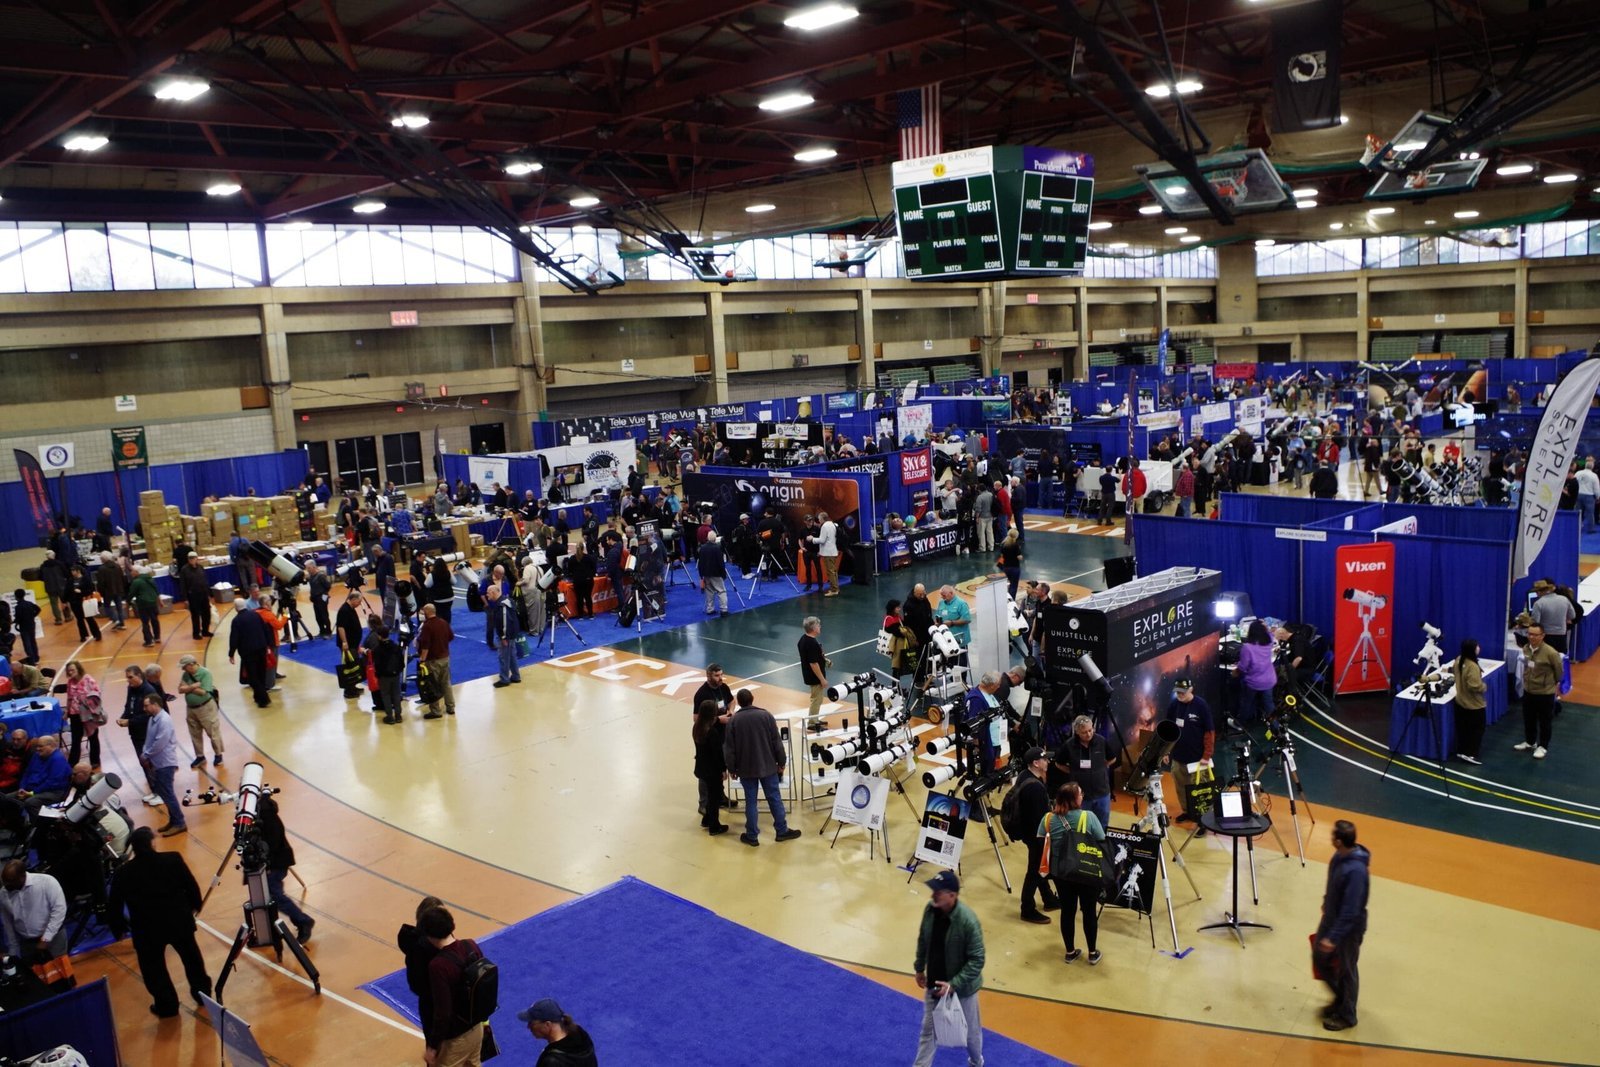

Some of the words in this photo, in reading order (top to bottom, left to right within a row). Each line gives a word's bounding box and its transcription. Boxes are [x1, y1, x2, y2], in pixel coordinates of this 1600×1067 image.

[967, 200, 991, 213] GUEST
[1026, 199, 1042, 210] HOME
[1072, 203, 1088, 213] GUEST
[903, 209, 924, 221] HOME
[937, 211, 955, 219] PERIOD
[981, 234, 998, 243] FOULS
[1020, 233, 1033, 241] FOULS
[904, 243, 919, 251] FOULS
[933, 240, 952, 248] PLAYER
[944, 264, 962, 272] MATCH
[984, 261, 1001, 269] SCORE
[907, 268, 922, 276] SCORE
[659, 411, 678, 421] Tele
[679, 410, 696, 419] Vue
[709, 407, 727, 416] Tele
[728, 405, 744, 414] Vue
[609, 417, 627, 427] Tele
[628, 416, 646, 425] Vue
[903, 456, 920, 472] SKY
[920, 455, 927, 467] &
[904, 468, 928, 480] TELESCOPE
[1345, 561, 1387, 574] Vixen
[1133, 600, 1194, 637] EXPLORE
[1050, 630, 1099, 642] UNISTELLAR
[1133, 618, 1194, 649] SCIENTIFIC
